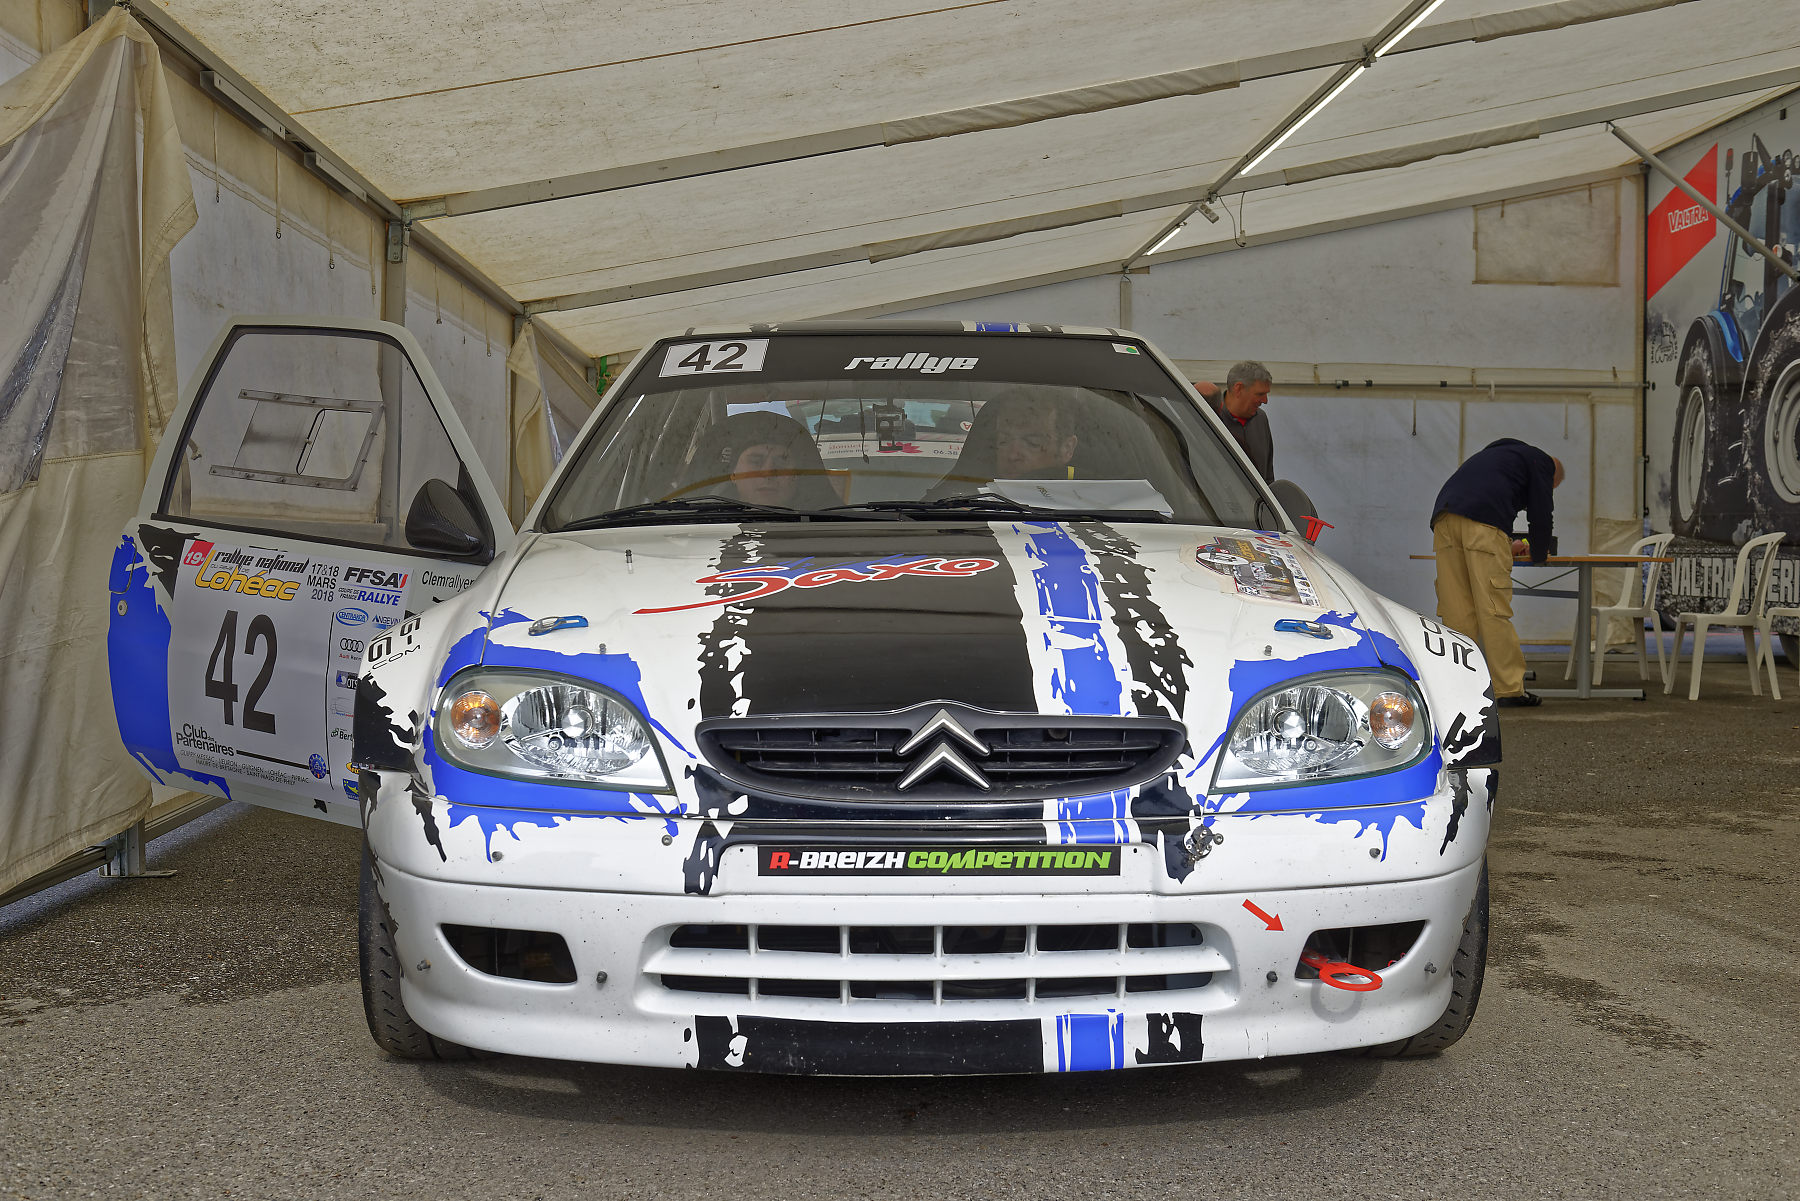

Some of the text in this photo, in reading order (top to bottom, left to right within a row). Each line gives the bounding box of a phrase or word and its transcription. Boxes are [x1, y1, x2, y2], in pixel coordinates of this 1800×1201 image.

[1668, 205, 1709, 233] VALTRA
[677, 342, 749, 372] 42
[844, 352, 979, 374] rallye
[214, 548, 310, 575] rallye national
[311, 563, 340, 577] 17&18
[195, 550, 301, 601] Lohéac
[306, 575, 337, 590] MARS
[344, 567, 399, 588] FFSA
[631, 557, 1000, 614] Saxo
[311, 589, 335, 602] 2018
[357, 590, 400, 606] RALLYE
[205, 610, 277, 734] 42
[182, 722, 208, 740] Club
[176, 732, 235, 757] Partenaires
[769, 848, 1112, 873] R-BREIZH COMPETITION
